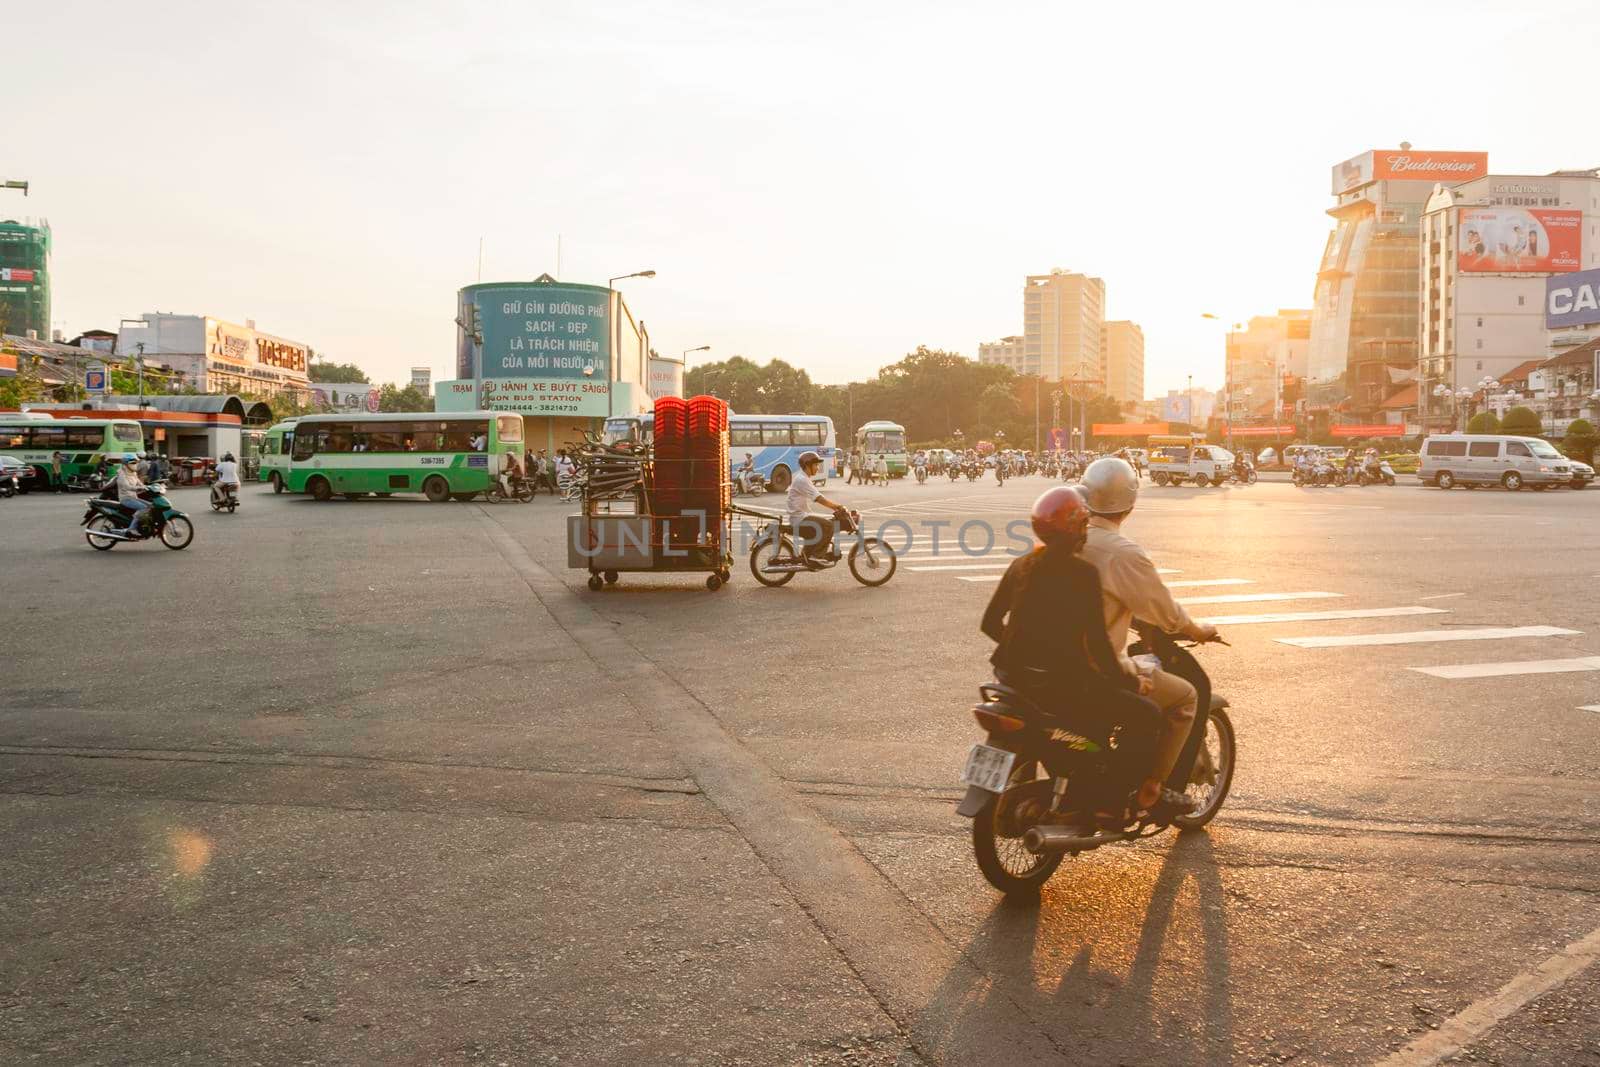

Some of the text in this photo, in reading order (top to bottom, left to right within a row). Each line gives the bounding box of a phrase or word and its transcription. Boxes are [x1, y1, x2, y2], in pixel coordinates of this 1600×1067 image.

[1386, 154, 1475, 172] Budweiser
[1549, 284, 1600, 315] CA
[525, 321, 555, 334] SẠCH
[567, 322, 588, 335] ĐẸP
[510, 336, 524, 350] LÀ
[528, 336, 565, 350] TRÁCH
[256, 337, 305, 372] TOSHIBA
[502, 353, 523, 369] CỦA
[532, 383, 546, 391] XE
